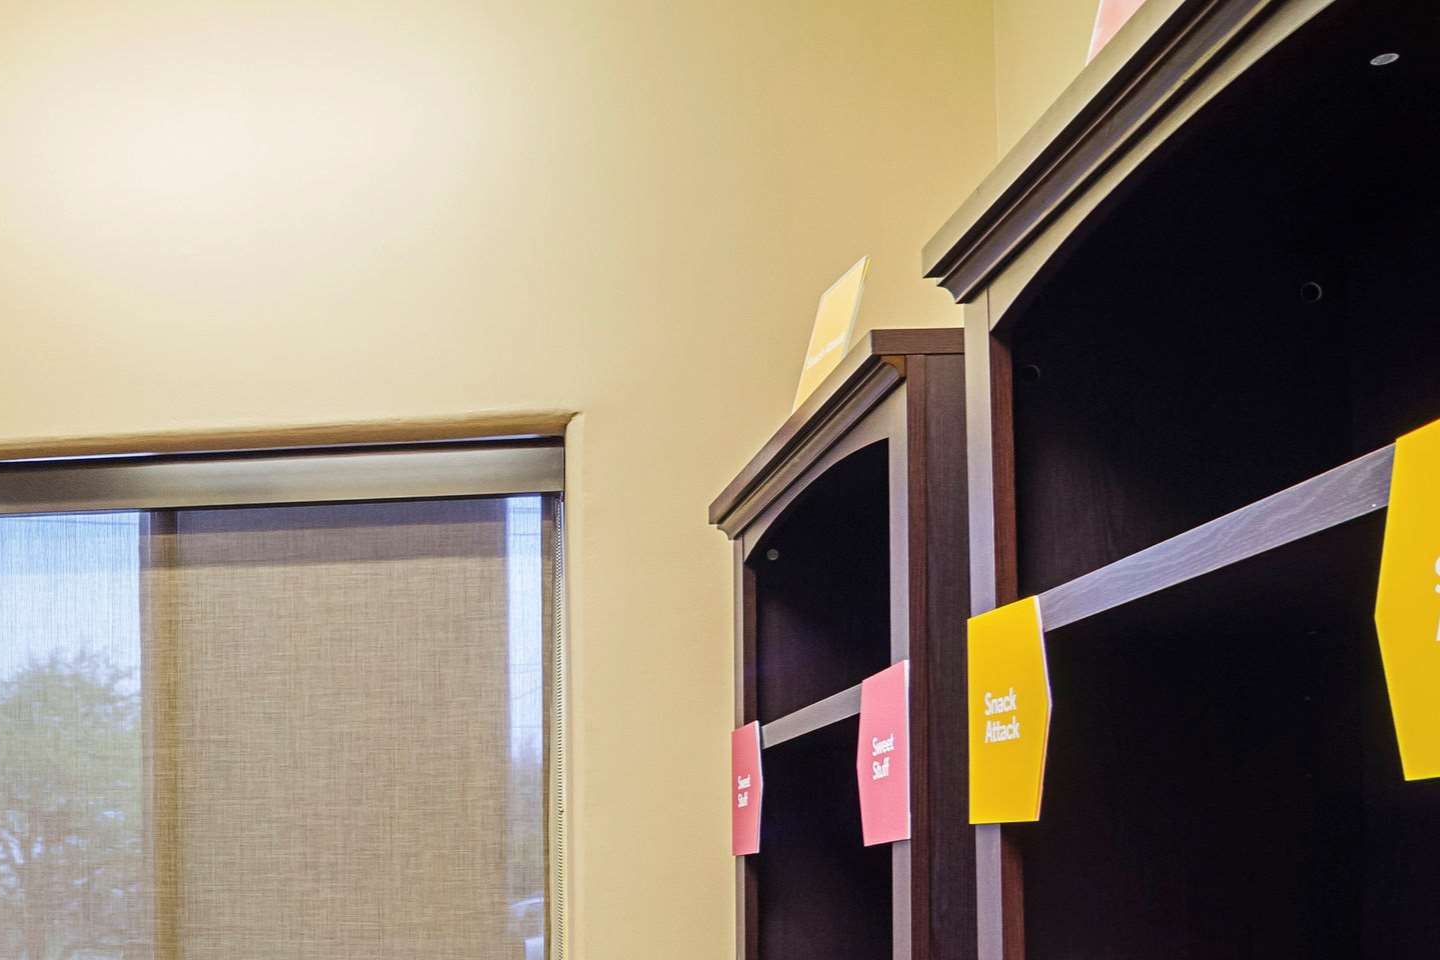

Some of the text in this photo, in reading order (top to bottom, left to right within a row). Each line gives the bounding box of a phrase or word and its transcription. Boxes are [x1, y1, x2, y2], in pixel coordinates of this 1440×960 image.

[984, 688, 1017, 716] Snack
[984, 716, 1021, 744] Attack
[872, 733, 895, 756] Sweet
[872, 757, 890, 780] Stuff
